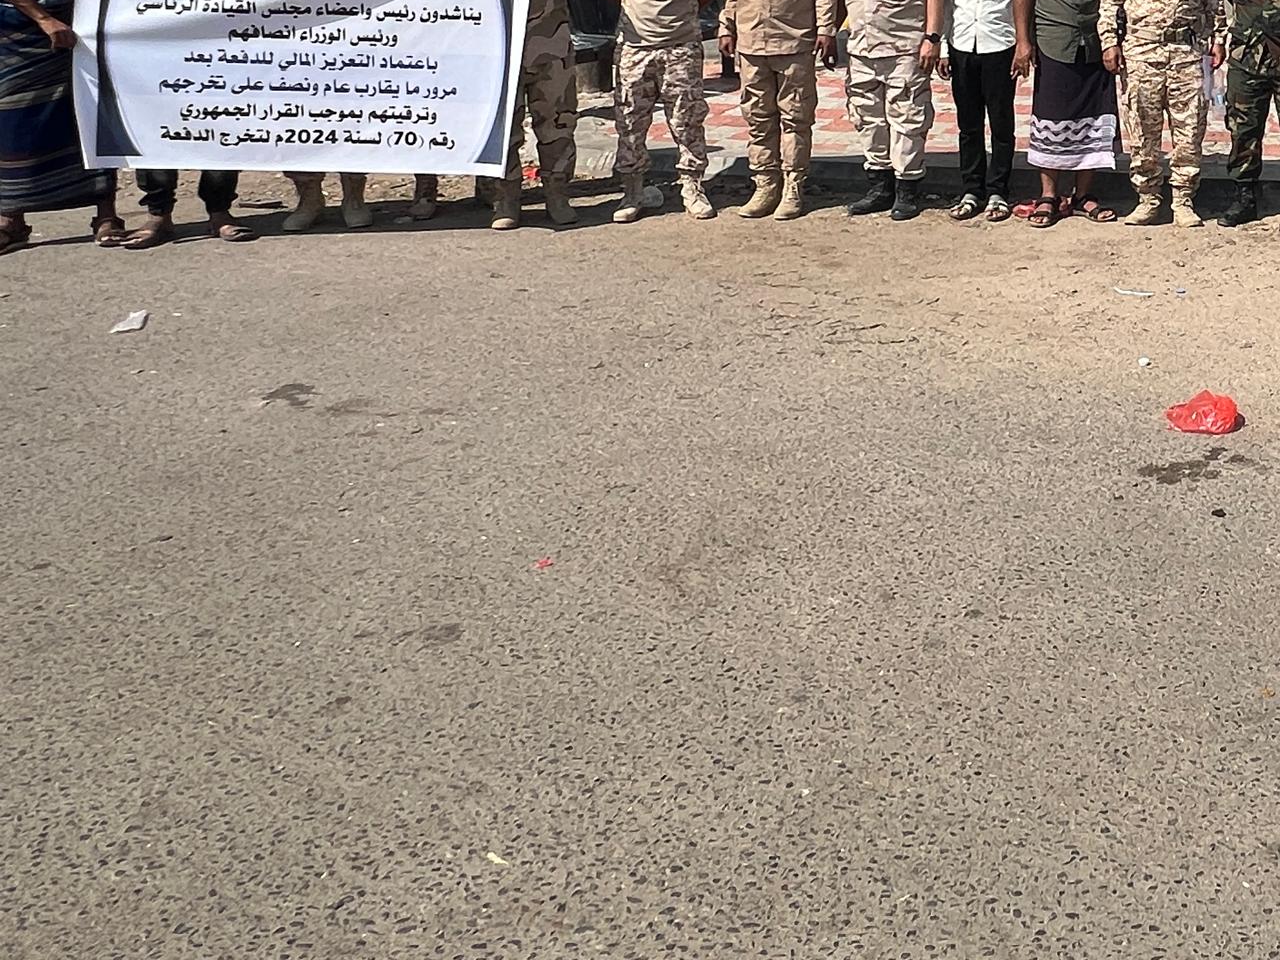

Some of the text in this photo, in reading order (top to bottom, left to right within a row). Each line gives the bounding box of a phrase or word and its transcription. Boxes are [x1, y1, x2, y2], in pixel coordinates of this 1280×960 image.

[201, 0, 257, 16] القيادة
[261, 5, 312, 18] مجلس
[315, 4, 372, 21] واعضاء
[375, 4, 416, 22] رئيس
[419, 5, 481, 25] يناشدون
[227, 24, 398, 47] ورئيس الوزراء انصافهم
[183, 49, 438, 71] باعتماد التعزيز المالي للدفعة بعد
[158, 75, 457, 100] مرور ما يقارب عام ونصف على تخرجهم
[179, 102, 437, 125] وترقيتهم بموجب القرار الجمهوري
[159, 126, 215, 141] الدفعة
[217, 128, 271, 147] لتخرج
[342, 130, 382, 145] لسنة
[428, 132, 455, 150] رقم
